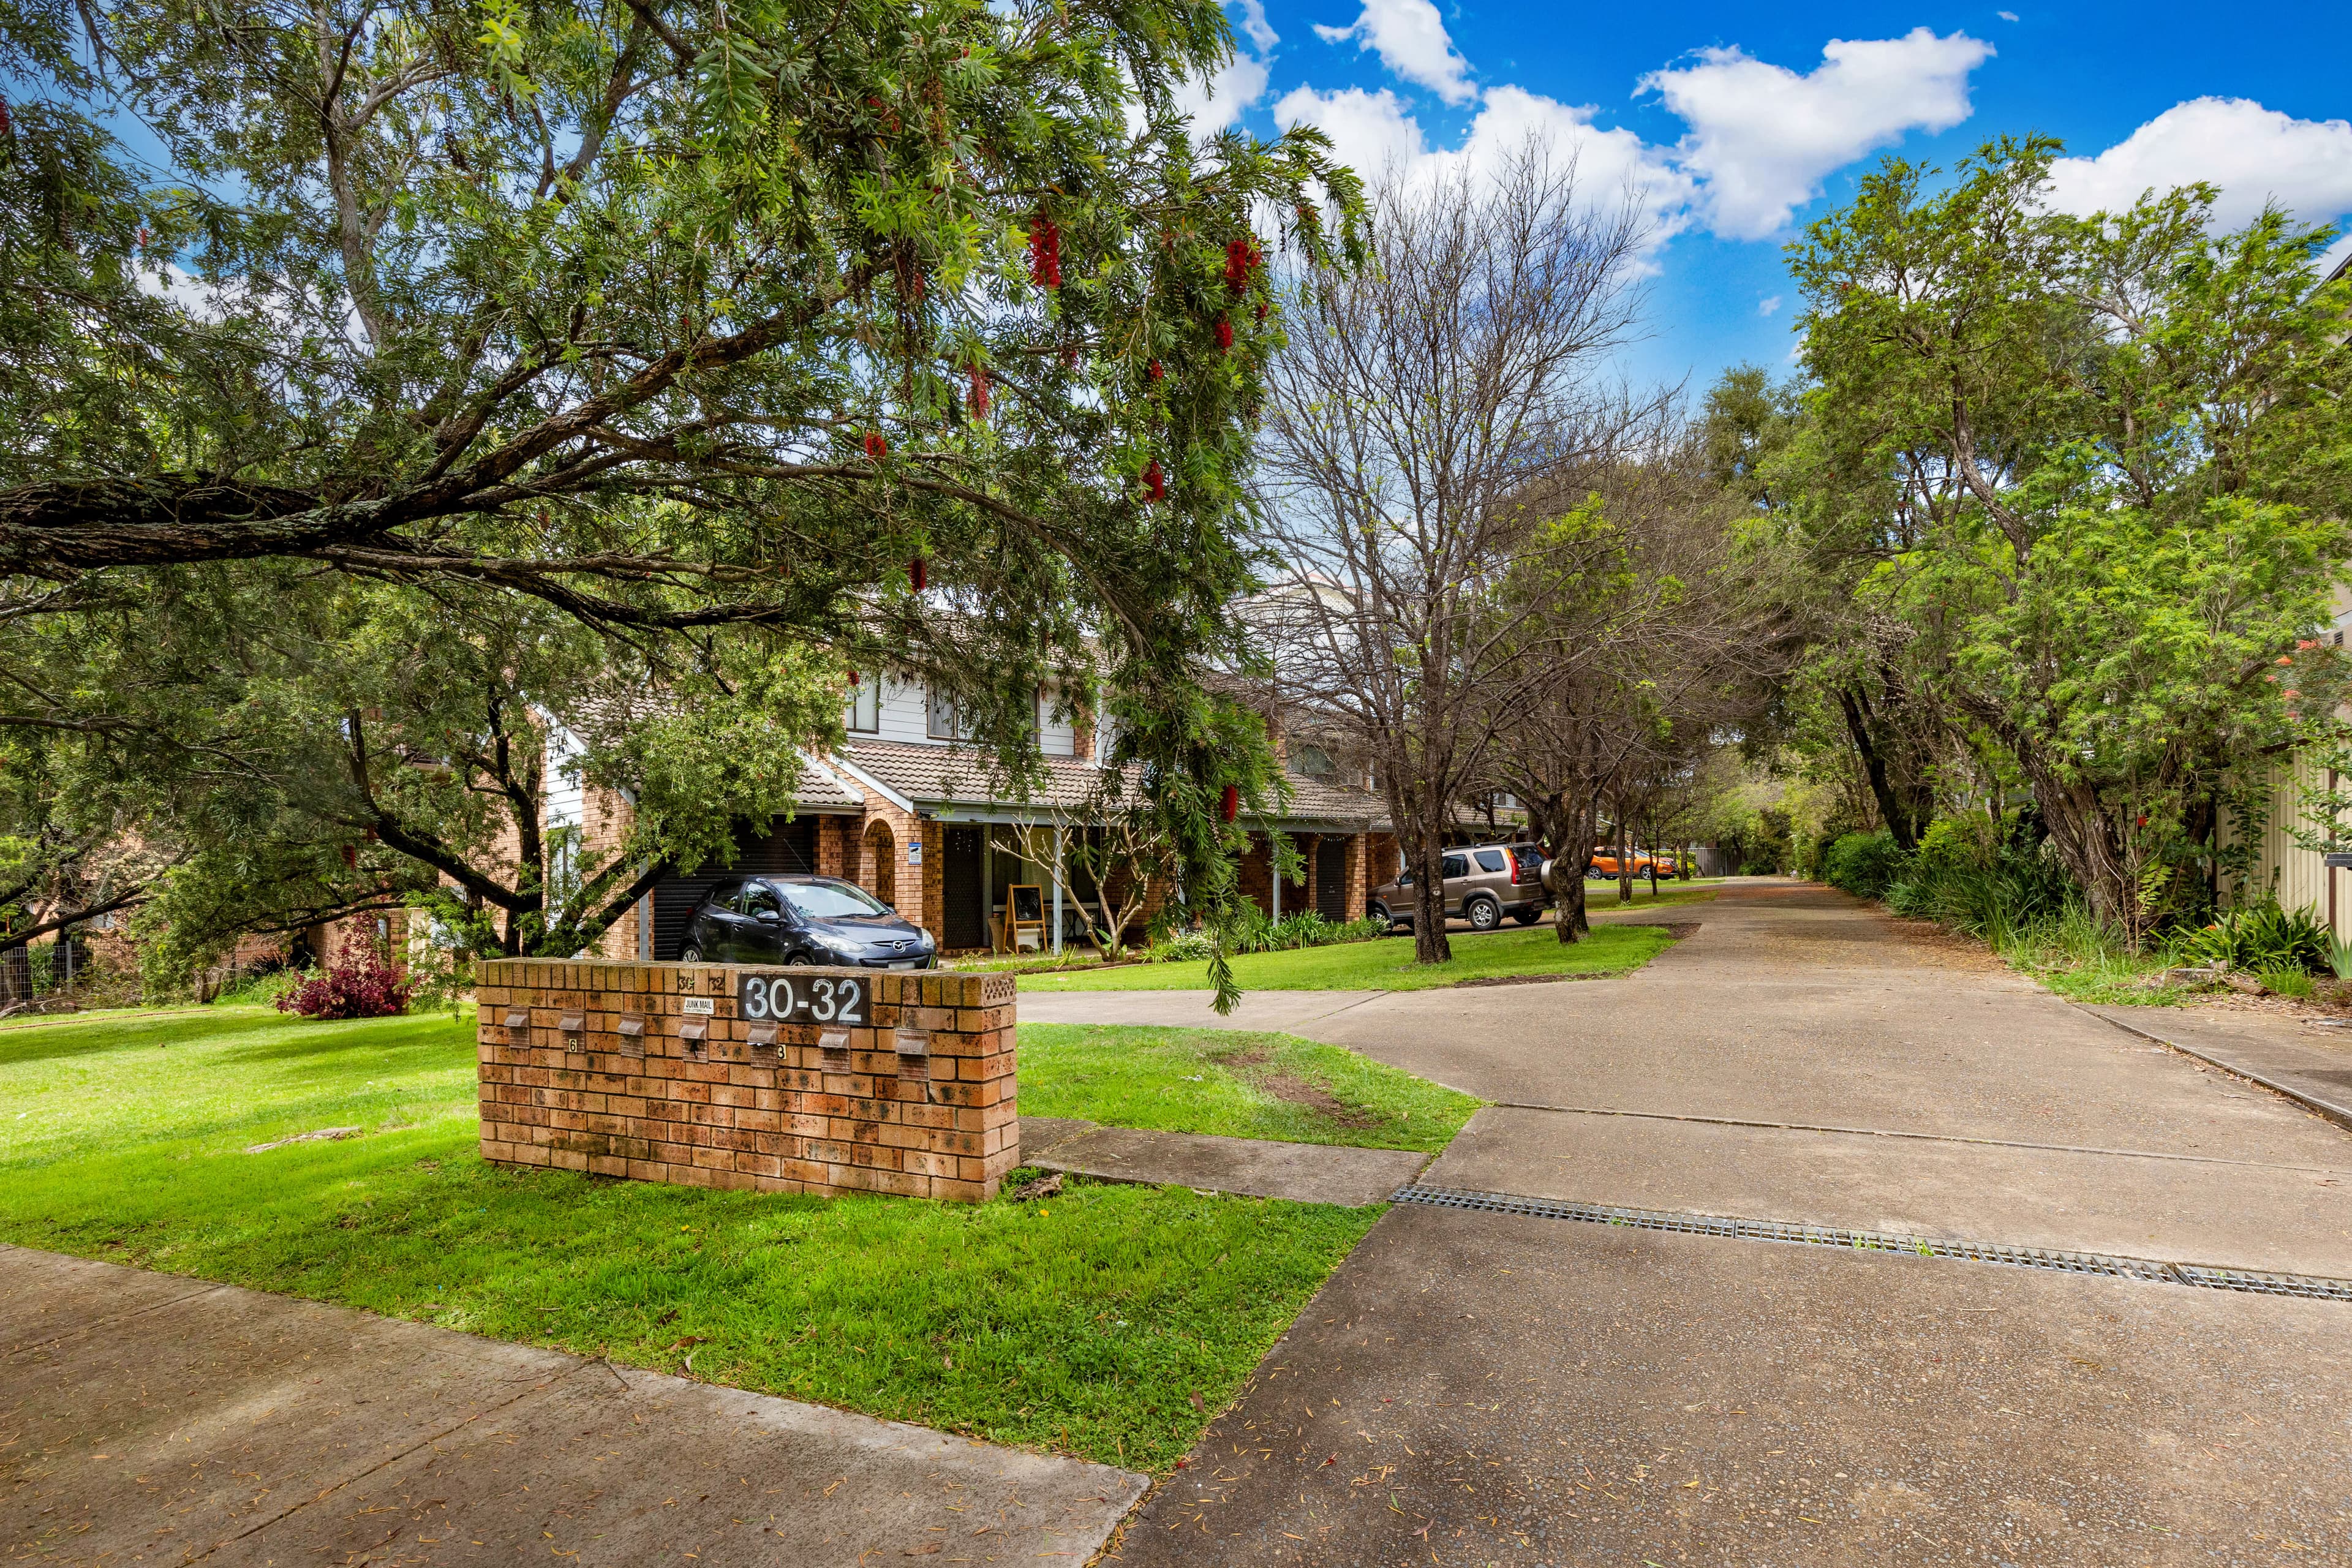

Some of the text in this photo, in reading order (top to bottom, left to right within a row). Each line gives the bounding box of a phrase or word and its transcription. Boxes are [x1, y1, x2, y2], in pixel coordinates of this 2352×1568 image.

[685, 1000, 712, 1009] JUNK MAIL
[745, 977, 862, 1022] 30-32
[570, 1039, 576, 1052] 6
[777, 1045, 785, 1058] 3
